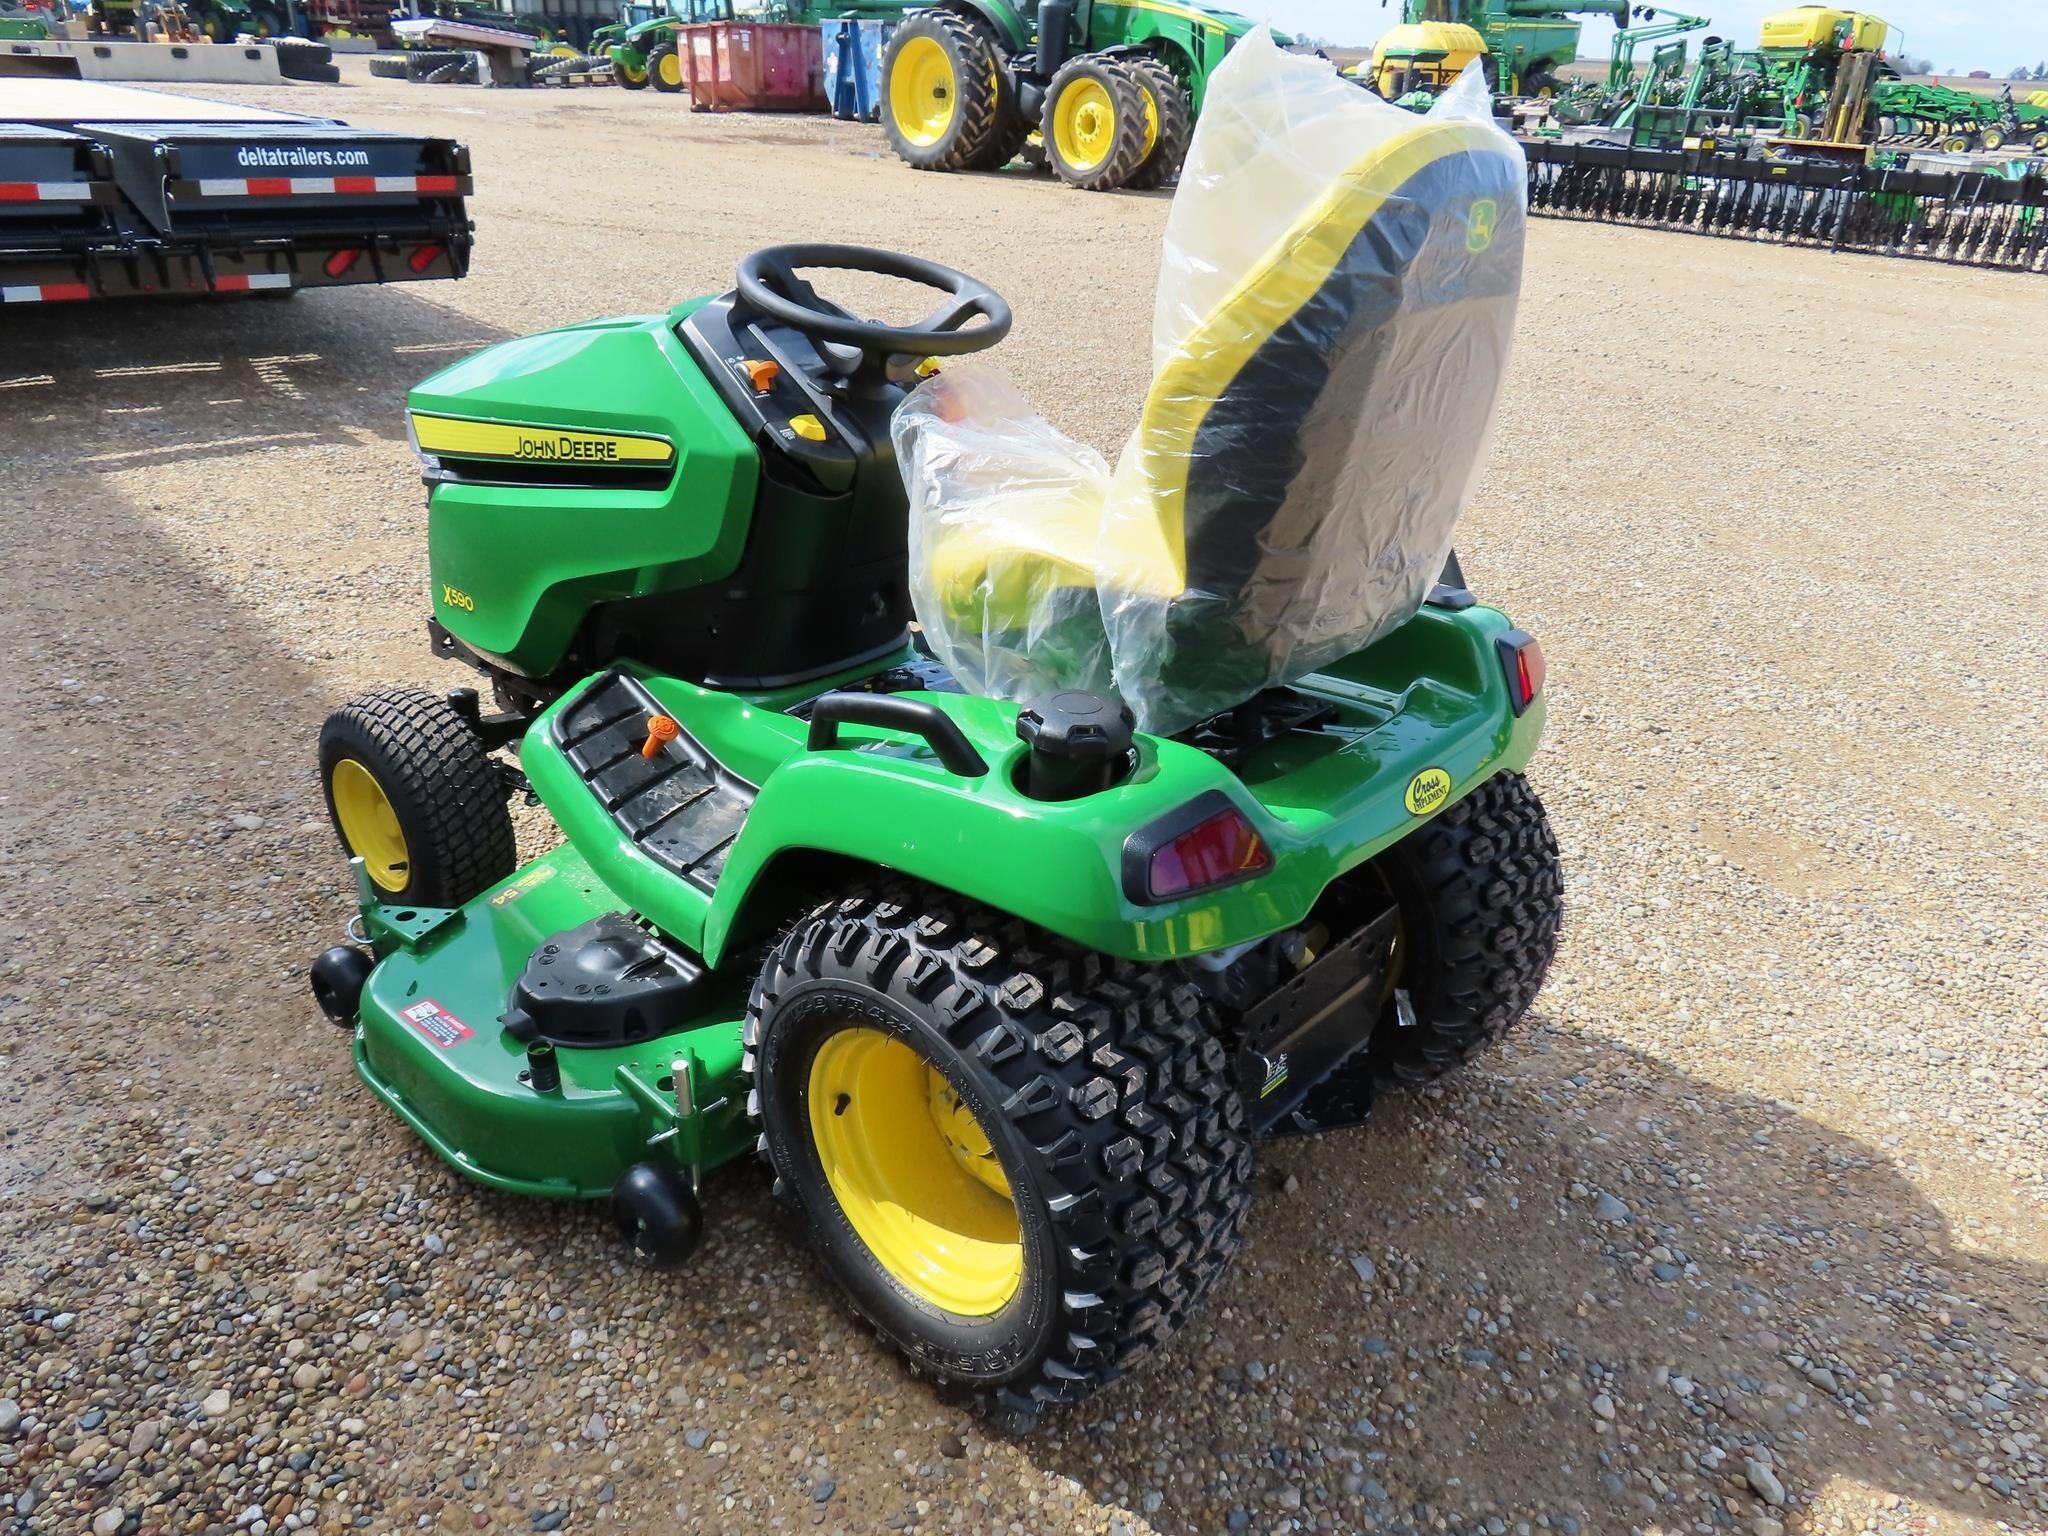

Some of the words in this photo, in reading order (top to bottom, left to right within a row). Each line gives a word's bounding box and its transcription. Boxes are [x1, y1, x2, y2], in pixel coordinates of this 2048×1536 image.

[238, 146, 369, 166] deltatrailers.com
[514, 435, 556, 457] JOHN
[559, 437, 618, 459] DEERE
[442, 583, 474, 612] X590
[1413, 777, 1440, 803] Cross
